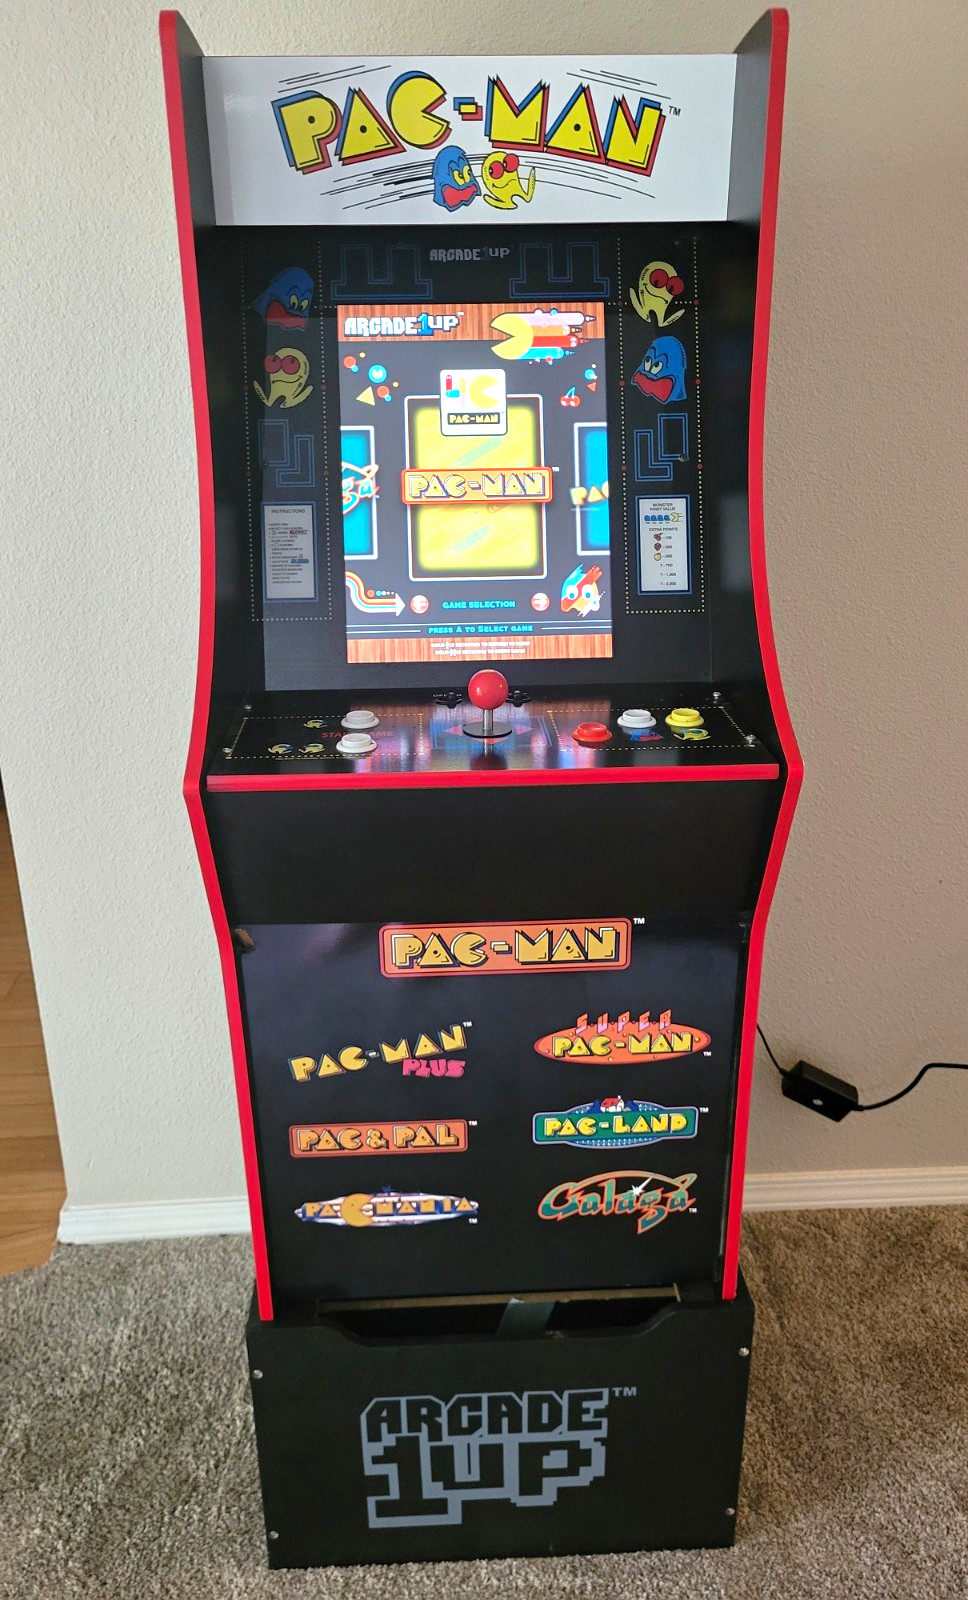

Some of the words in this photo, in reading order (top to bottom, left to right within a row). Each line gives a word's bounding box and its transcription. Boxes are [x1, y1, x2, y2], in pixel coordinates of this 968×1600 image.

[271, 70, 667, 177] PAC-MAN
[448, 414, 499, 424] PAC-MAN
[408, 472, 546, 499] PAC-MAN
[442, 601, 467, 609] GAME
[469, 600, 516, 608] SELECTION
[428, 626, 453, 634] PRESS
[456, 625, 462, 633] A
[391, 927, 620, 969] PAC-MAN
[575, 1009, 672, 1035] SUPER
[288, 1024, 467, 1082] PAC-MAN
[552, 1032, 693, 1058] PAC-MAN
[402, 1058, 466, 1078] PLUS
[296, 1128, 363, 1151] PAC
[366, 1128, 389, 1149] &
[393, 1124, 460, 1148] PAL
[544, 1113, 688, 1136] PAC-LAND
[537, 1170, 698, 1234] Galaga
[360, 1388, 609, 1443] ARCADE
[364, 1434, 606, 1528] 1UP
